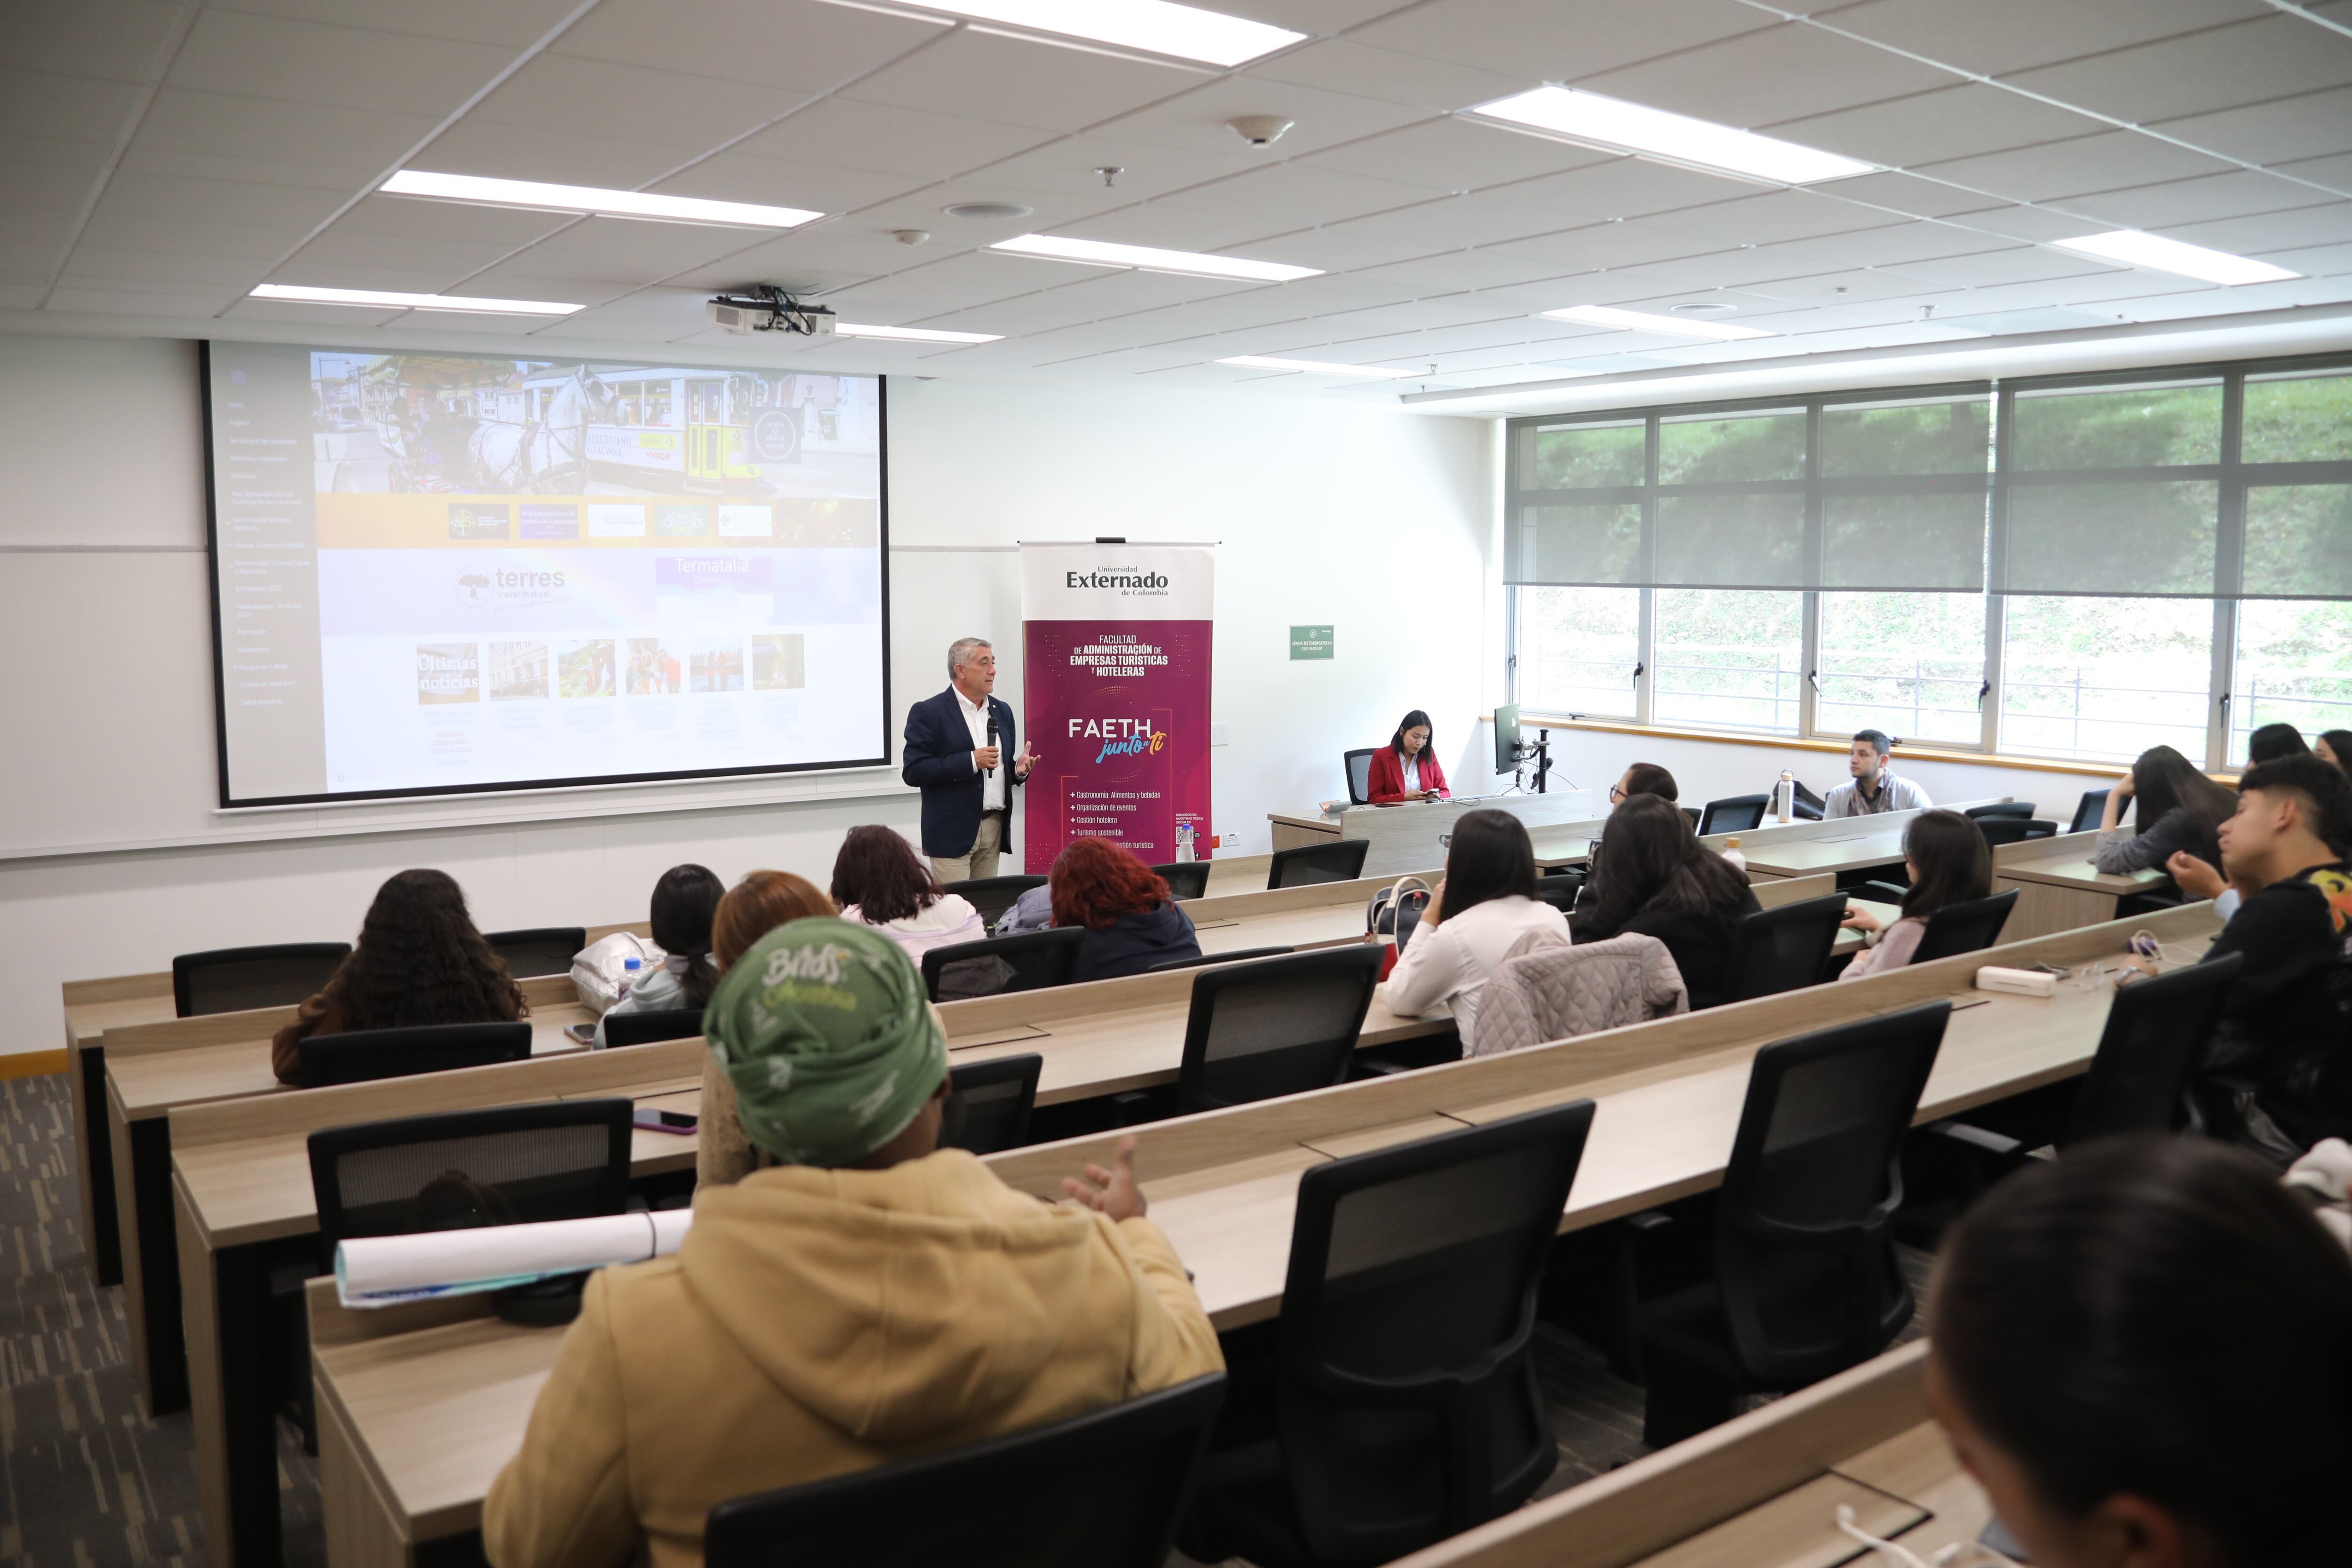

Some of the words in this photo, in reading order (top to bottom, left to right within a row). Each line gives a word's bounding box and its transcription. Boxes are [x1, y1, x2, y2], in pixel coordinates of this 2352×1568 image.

[646, 452, 670, 461] VIGOR
[675, 557, 749, 573] Termatalia
[496, 568, 565, 588] terres
[1067, 572, 1168, 588] Externado
[497, 590, 520, 598] travel
[522, 589, 550, 598] festival
[1099, 635, 1136, 644] FACULTAD
[1083, 643, 1152, 654] ADMINISTRACIÓN
[418, 654, 477, 671] Últimas
[1070, 655, 1117, 666] EMPRESAS
[1118, 653, 1168, 666] TURÍSTICAS
[1097, 667, 1144, 677] HOTELERAS
[421, 675, 478, 690] noticias
[1069, 719, 1151, 738] FAETH
[1096, 733, 1144, 764] junto
[1149, 731, 1167, 755] ti
[1077, 804, 1108, 812] Organización
